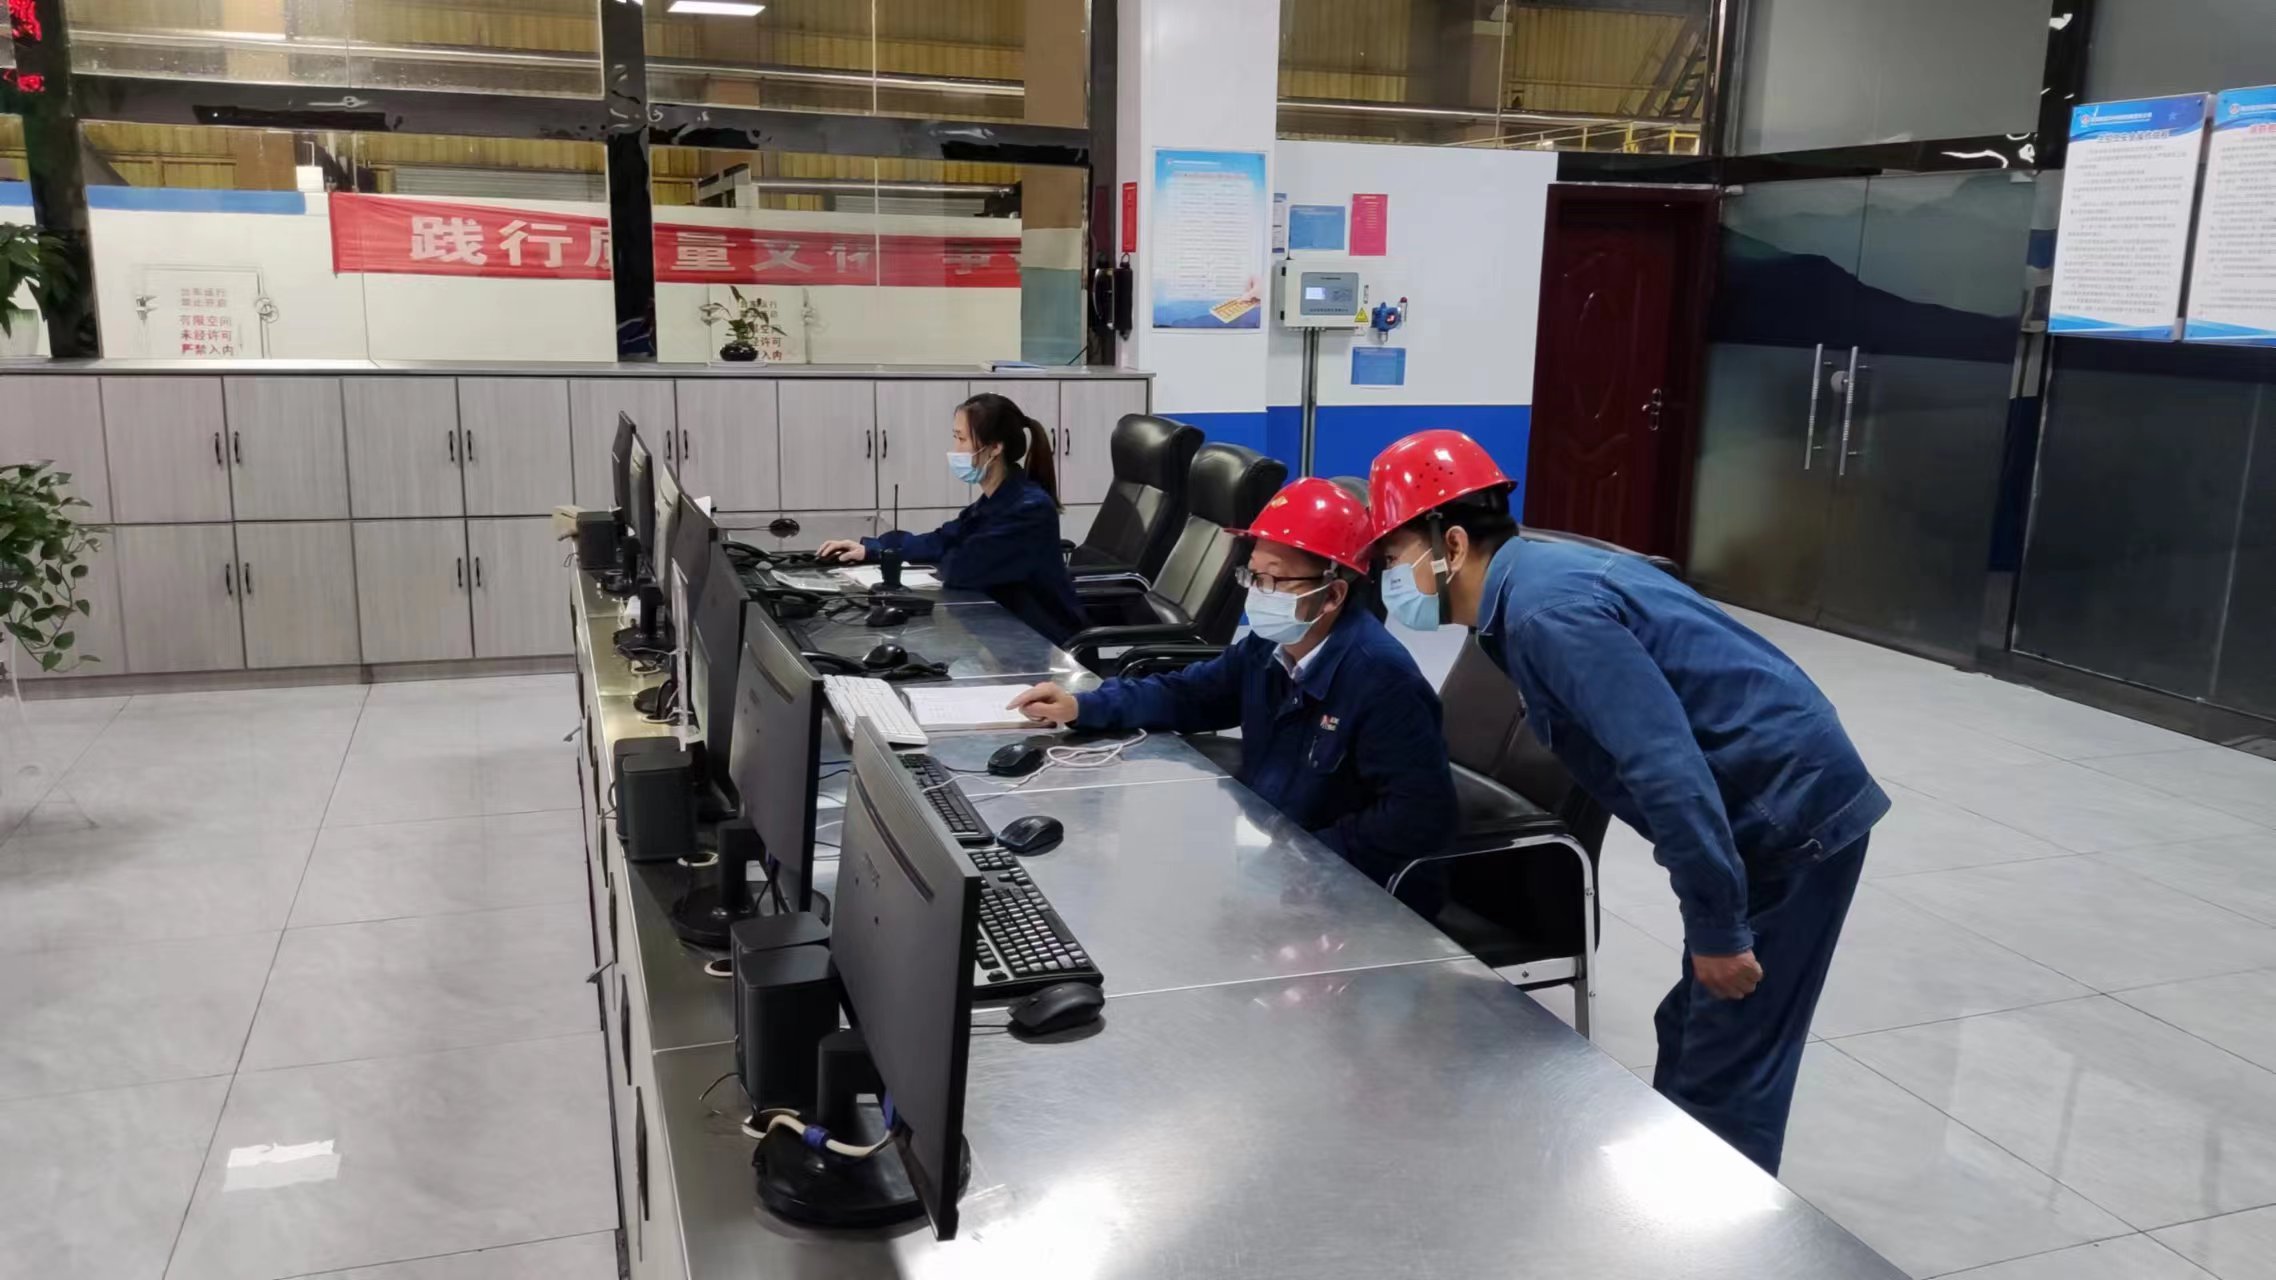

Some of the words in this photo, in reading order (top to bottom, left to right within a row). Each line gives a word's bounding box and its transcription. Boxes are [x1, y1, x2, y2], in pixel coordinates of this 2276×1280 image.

[179, 315, 232, 327] 有限空间
[181, 329, 232, 341] 未经许可
[181, 343, 234, 356] 严禁入内
